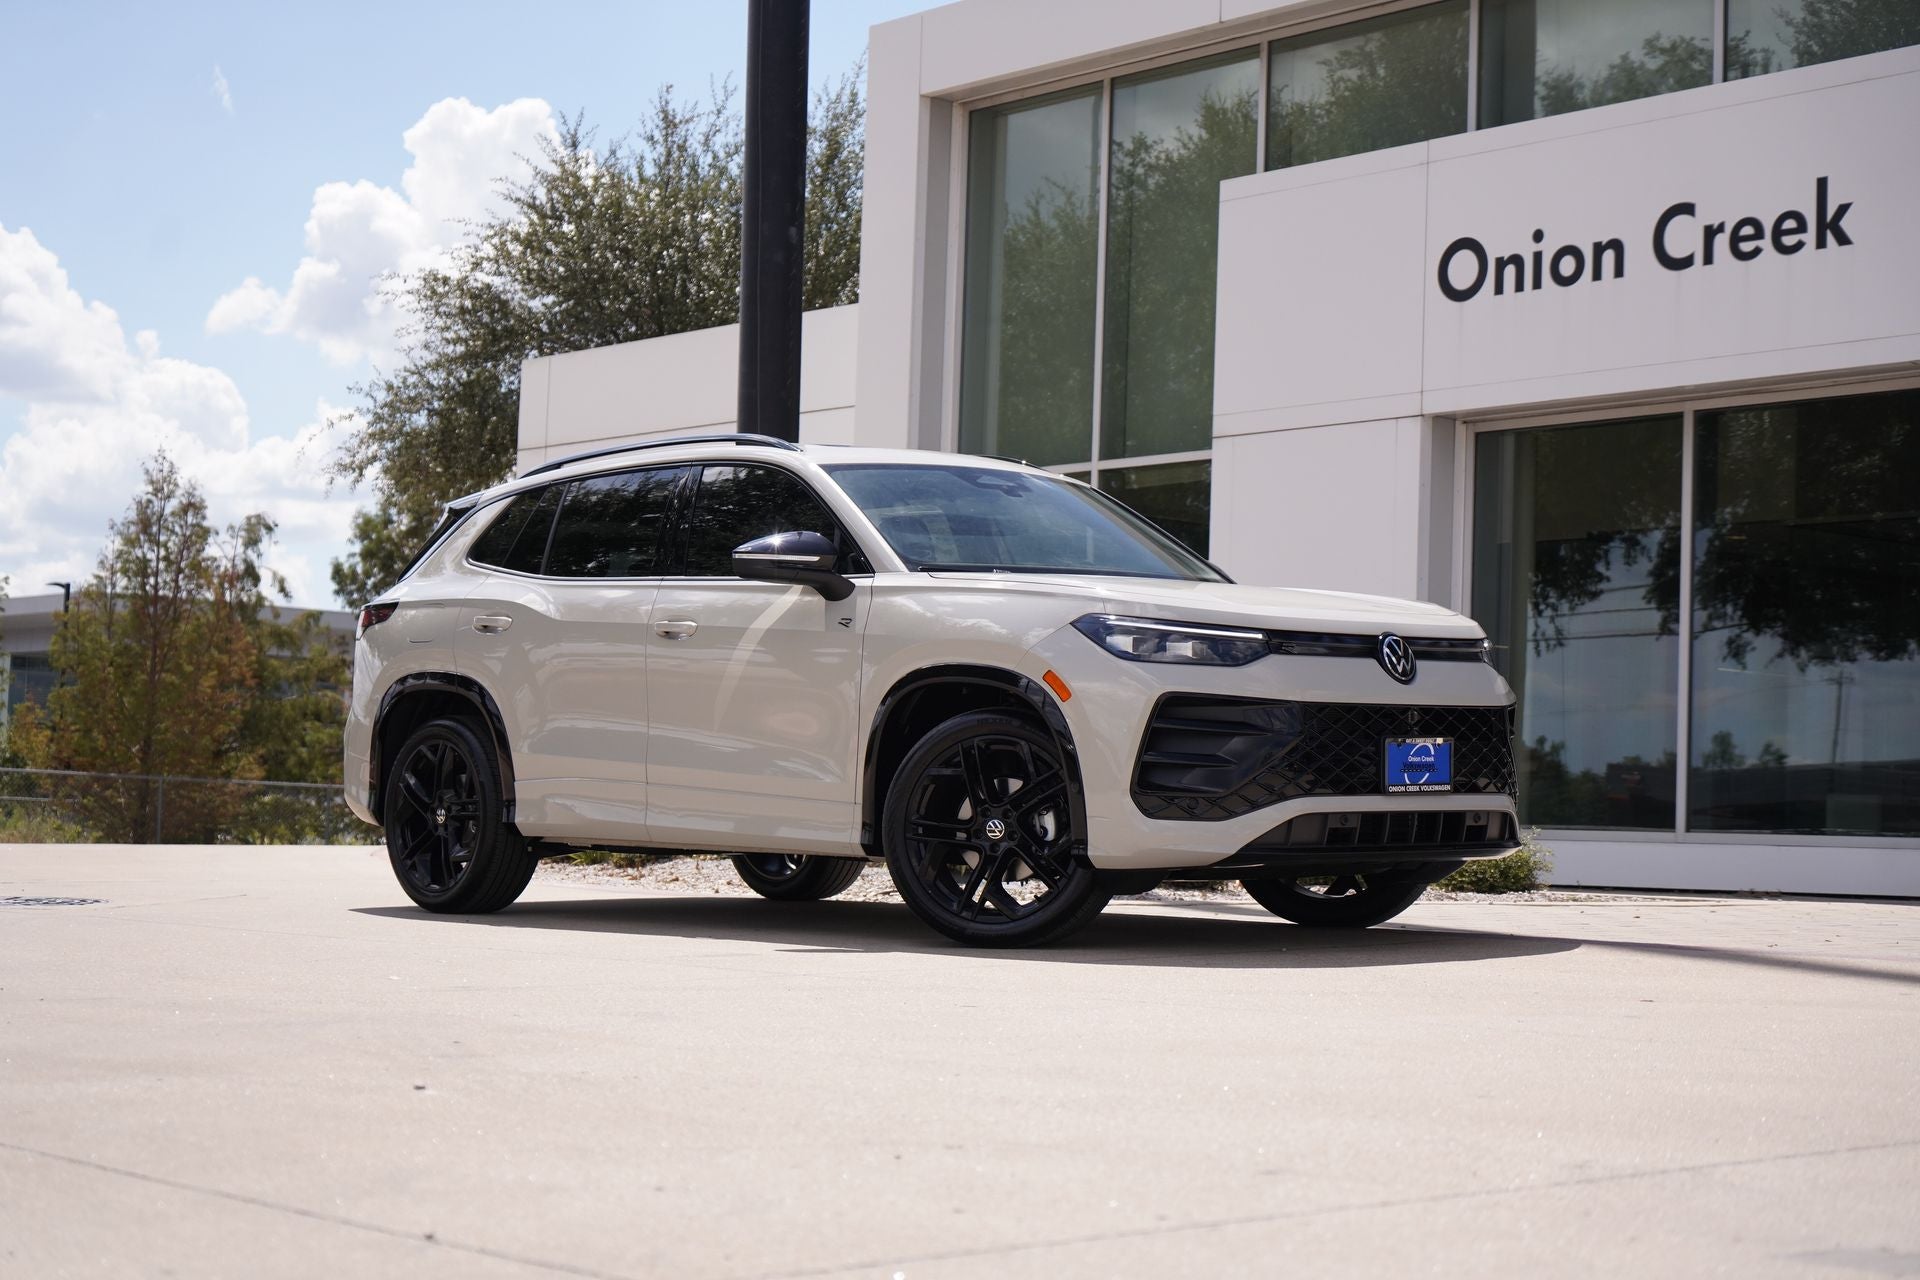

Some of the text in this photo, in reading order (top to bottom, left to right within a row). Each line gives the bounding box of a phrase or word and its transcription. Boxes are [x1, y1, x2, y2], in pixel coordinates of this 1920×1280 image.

[1437, 175, 1854, 303] Onion Creek
[1383, 636, 1415, 680] VW
[1389, 785, 1405, 793] ONION
[1421, 784, 1451, 792] VOLKSWAGEN
